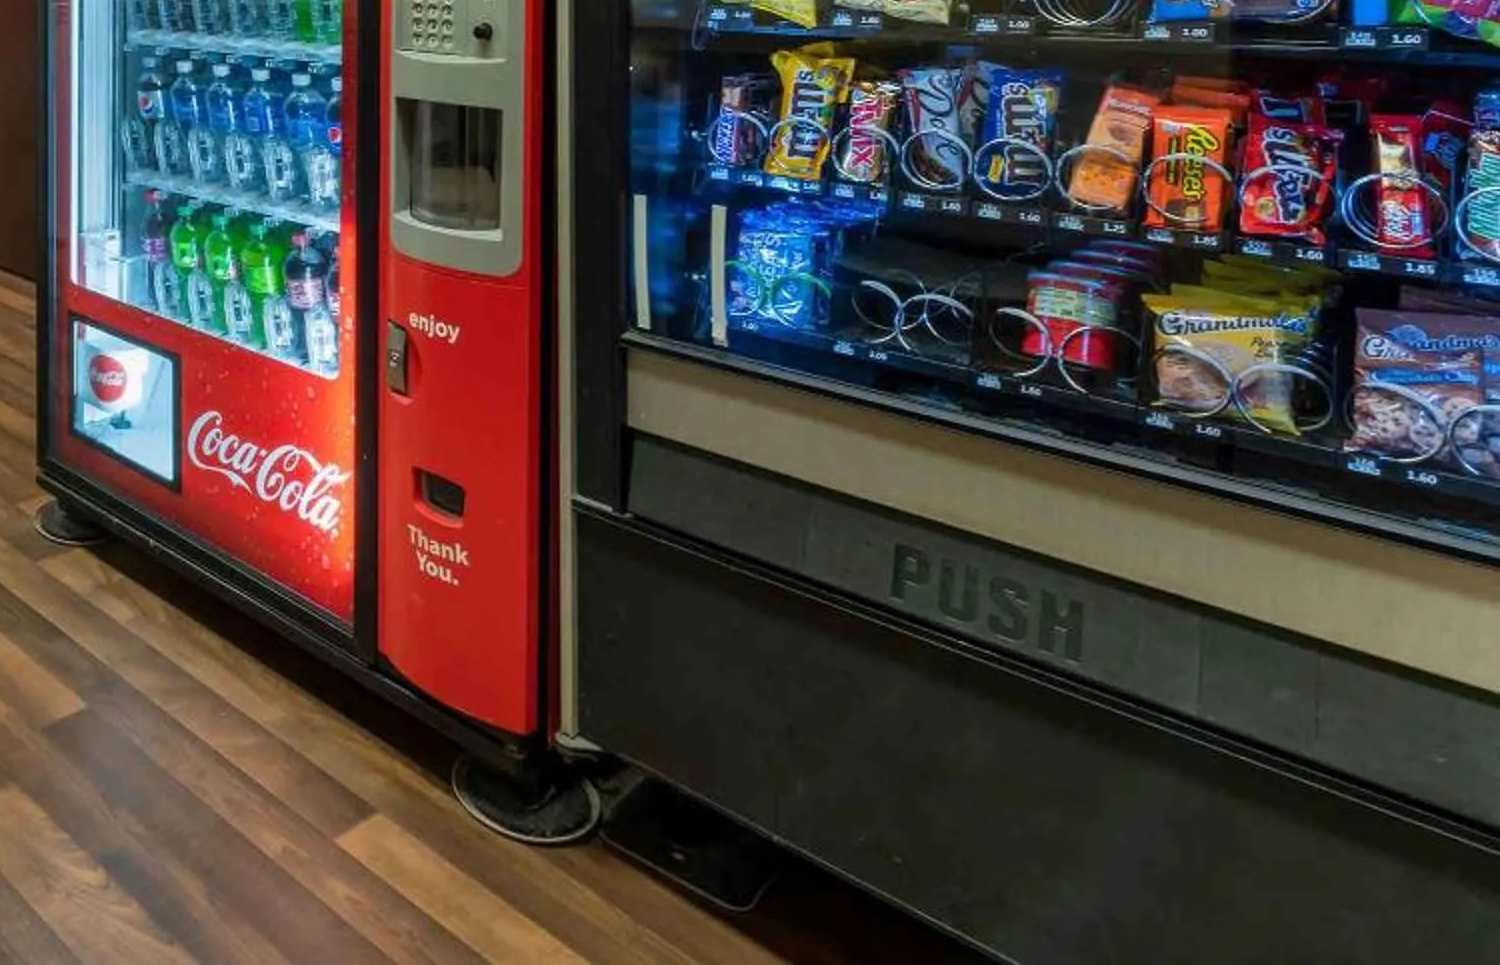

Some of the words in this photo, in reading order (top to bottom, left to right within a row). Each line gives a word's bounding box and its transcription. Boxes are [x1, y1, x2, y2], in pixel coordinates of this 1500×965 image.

[1392, 34, 1422, 45] 1.60
[409, 312, 460, 343] enjoy
[1196, 425, 1221, 437] 1.60
[188, 411, 351, 532] Coca-Cola
[1407, 471, 1437, 485] 1.60
[407, 524, 469, 565] Thank
[416, 550, 459, 585] You.
[889, 543, 1084, 665] PUSH
